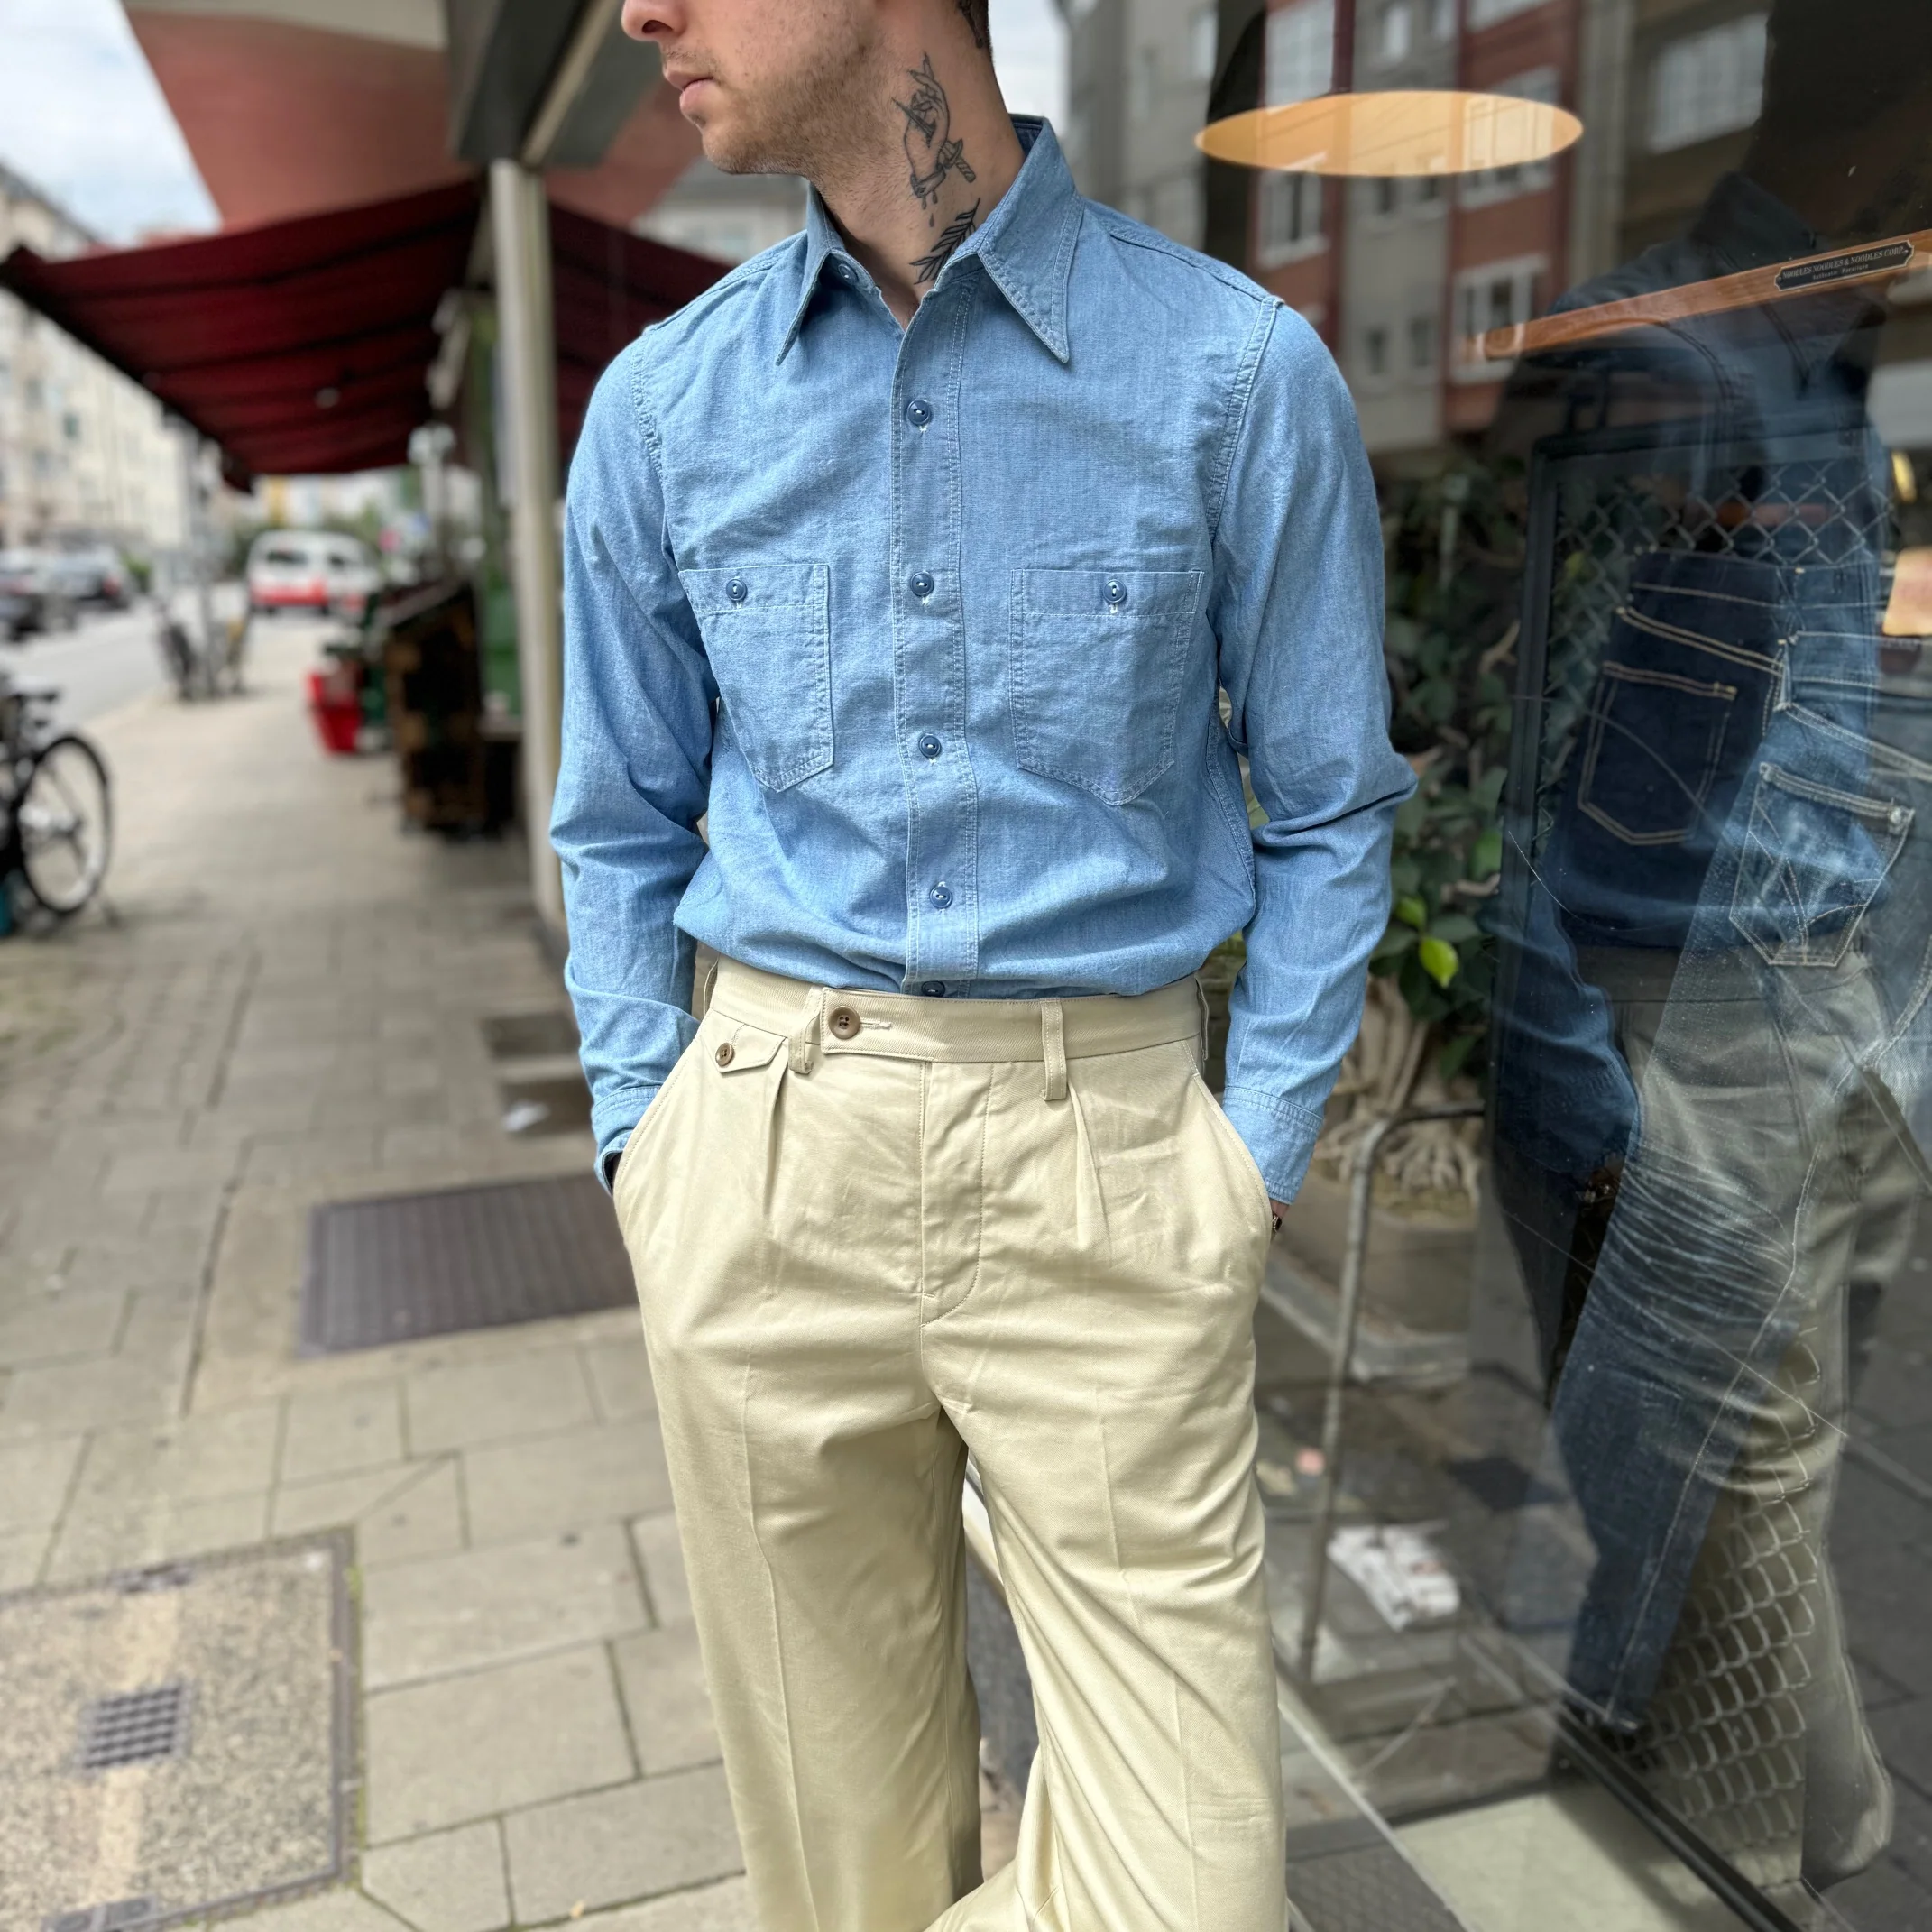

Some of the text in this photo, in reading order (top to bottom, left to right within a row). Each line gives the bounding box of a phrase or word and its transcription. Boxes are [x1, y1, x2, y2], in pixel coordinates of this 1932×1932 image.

[1782, 267, 1812, 279] NOODLES
[1812, 259, 1843, 272] NOODLES
[1844, 258, 1850, 266] &
[1851, 252, 1883, 264] NOODLES
